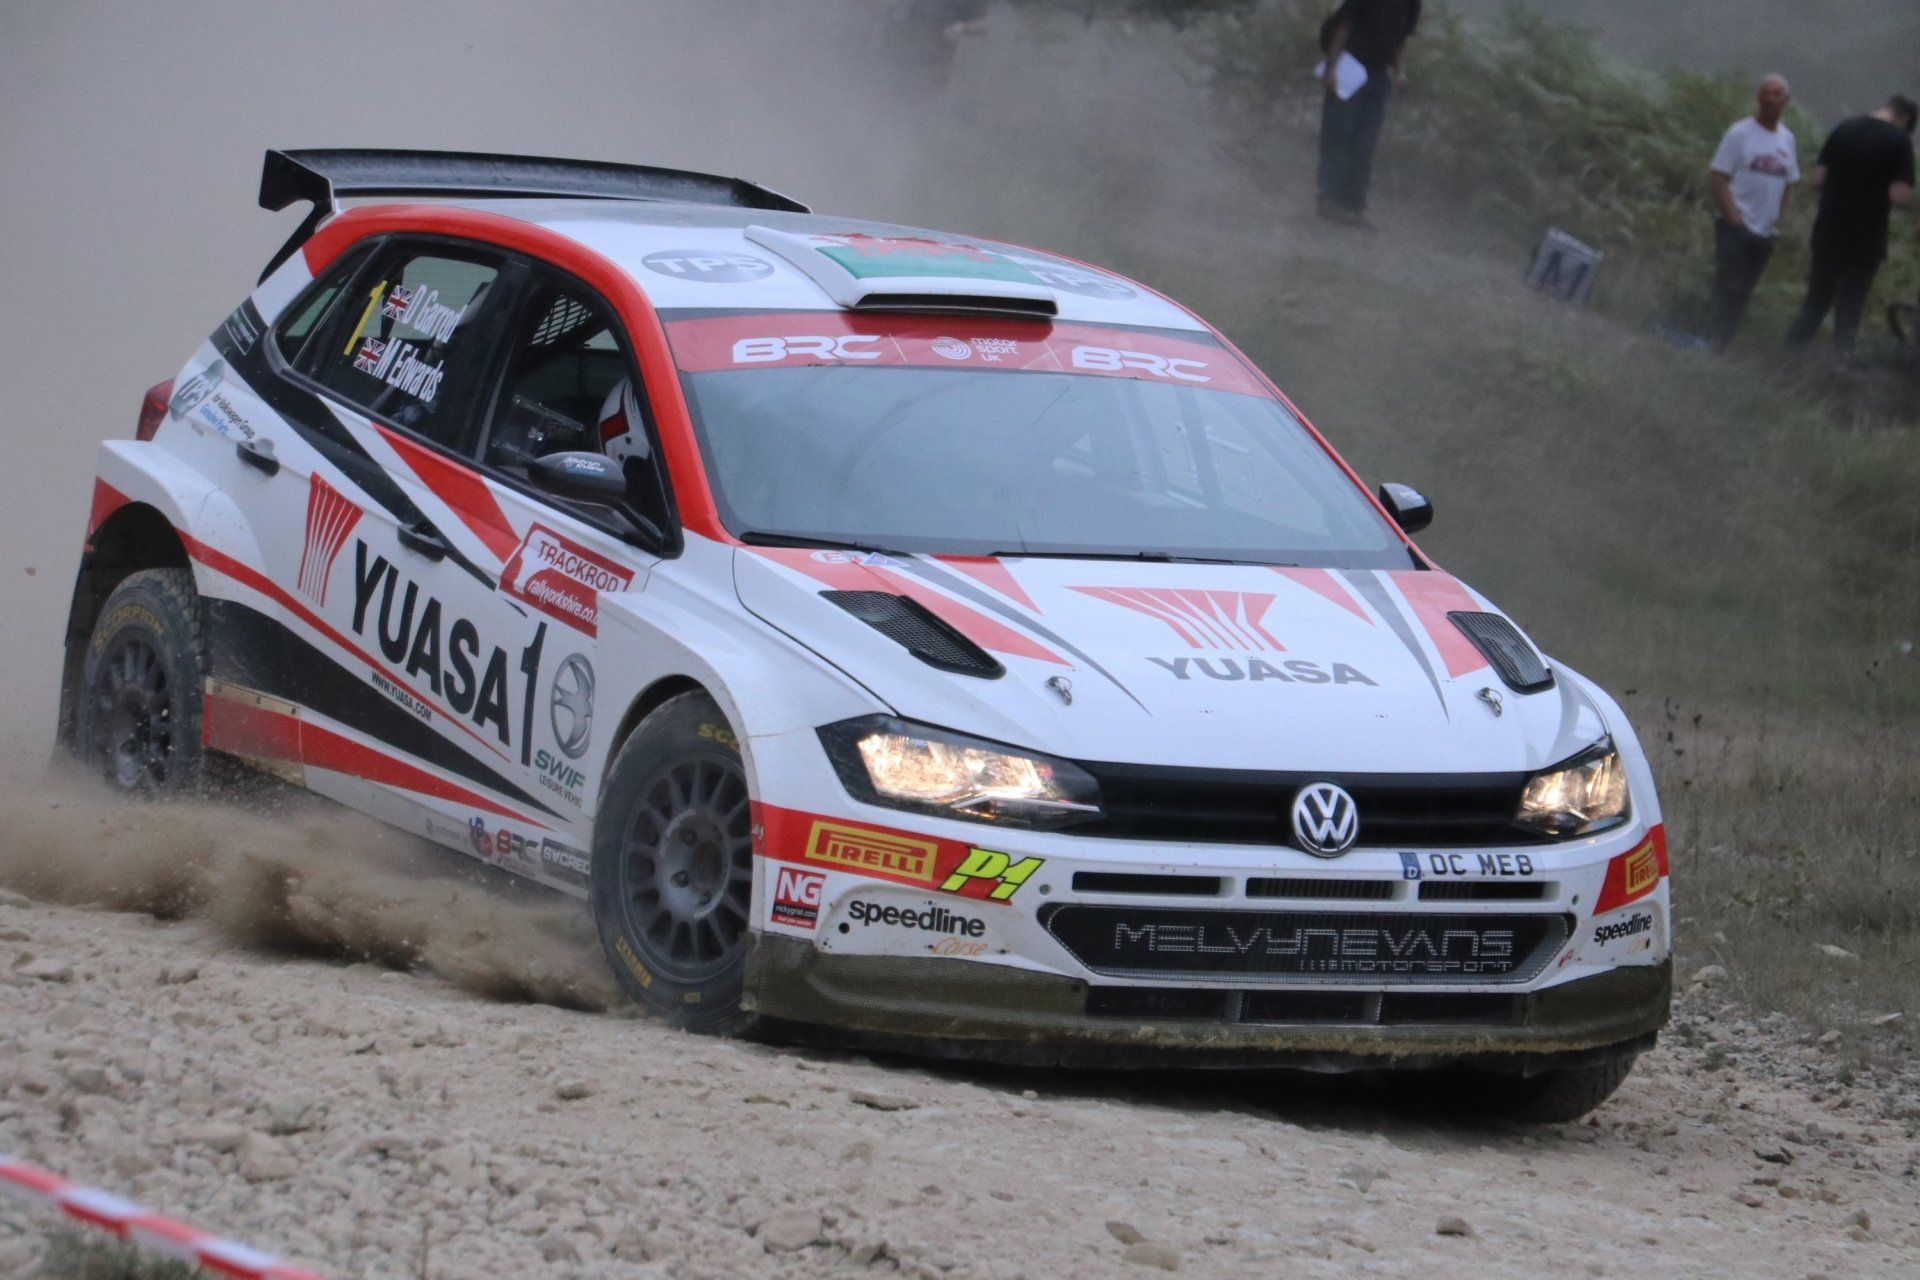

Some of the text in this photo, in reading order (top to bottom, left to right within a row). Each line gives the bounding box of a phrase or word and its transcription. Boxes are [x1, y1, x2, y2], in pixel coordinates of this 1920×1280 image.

[646, 257, 769, 273] TPS
[343, 279, 388, 356] 1
[402, 284, 468, 344] D Garrod
[733, 335, 882, 363] BRC
[971, 338, 1017, 346] motor
[976, 345, 1019, 354] sport
[980, 353, 1003, 362] UK
[371, 336, 444, 403] M Edwards
[1071, 345, 1211, 383] BRC
[217, 400, 241, 426] Volkswagen
[239, 420, 255, 440] Group
[538, 540, 619, 593] TRACKROD
[352, 538, 510, 747] YUASA
[1145, 656, 1381, 687] YUASA
[371, 669, 432, 722] WWW.YUASA.COM
[520, 620, 548, 767] 1
[496, 828, 540, 867] BRC
[814, 828, 930, 875] PIRELLI
[778, 870, 823, 905] NG
[1407, 867, 1419, 879] D
[849, 900, 986, 938] speedline
[1593, 912, 1653, 948] speedline
